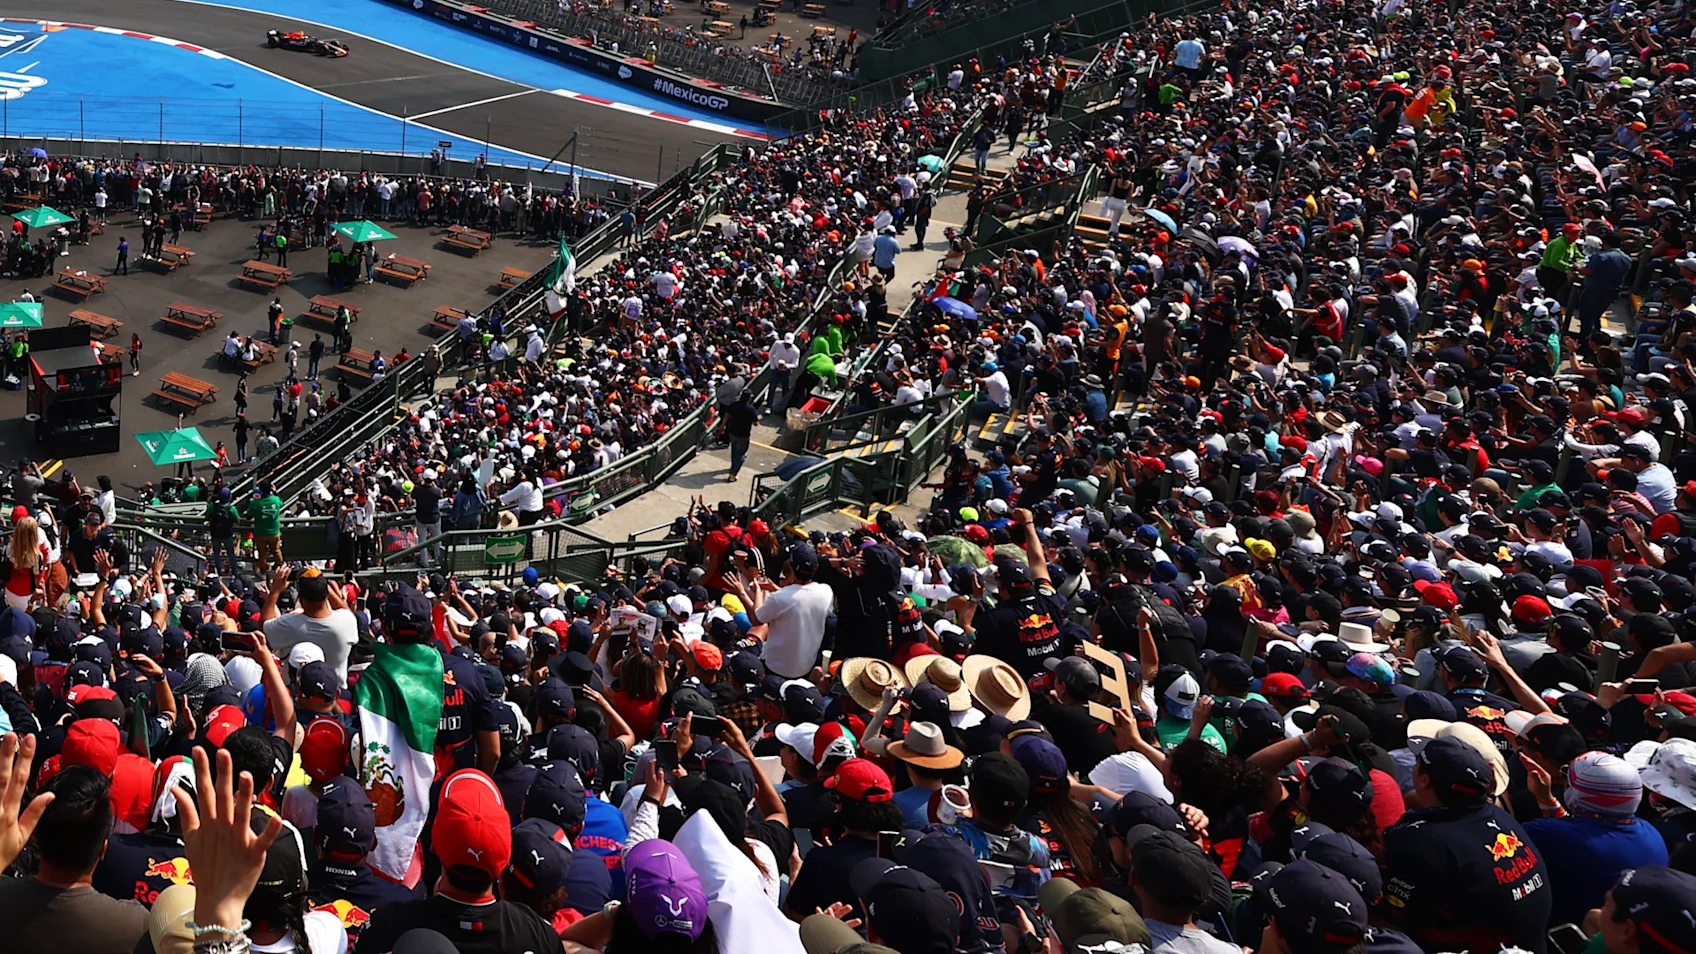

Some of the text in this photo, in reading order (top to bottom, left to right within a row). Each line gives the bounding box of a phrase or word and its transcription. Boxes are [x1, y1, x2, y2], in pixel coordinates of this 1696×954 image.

[654, 78, 729, 111] #MexicoGP
[1018, 623, 1060, 643] Red Bull
[1026, 642, 1053, 658] Mobil
[442, 687, 465, 707] ull
[325, 865, 357, 877] HONDA
[1492, 845, 1539, 886] Red Bull
[133, 880, 162, 905] Re
[1512, 878, 1534, 902] Mobil
